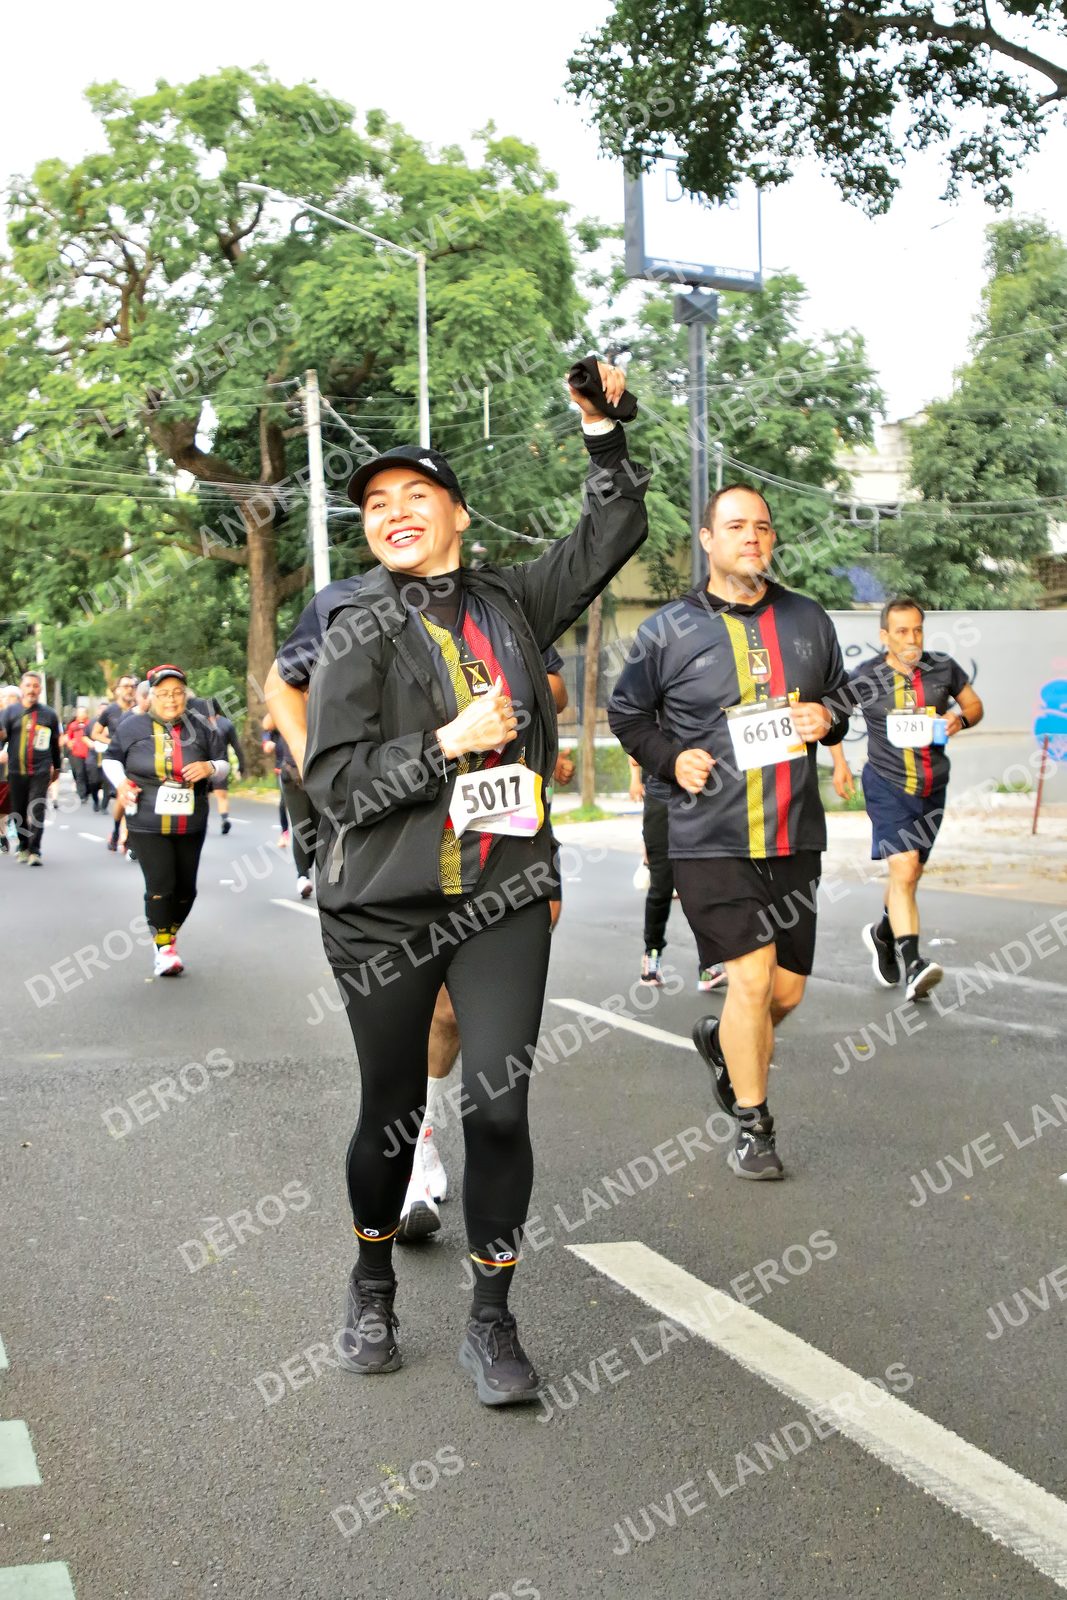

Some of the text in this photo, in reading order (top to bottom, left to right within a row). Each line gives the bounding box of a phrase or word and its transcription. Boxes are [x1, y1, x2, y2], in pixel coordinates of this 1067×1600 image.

[743, 717, 793, 744] 6618
[896, 720, 924, 732] 5781
[164, 792, 190, 803] 2925
[461, 775, 520, 814] 5017
